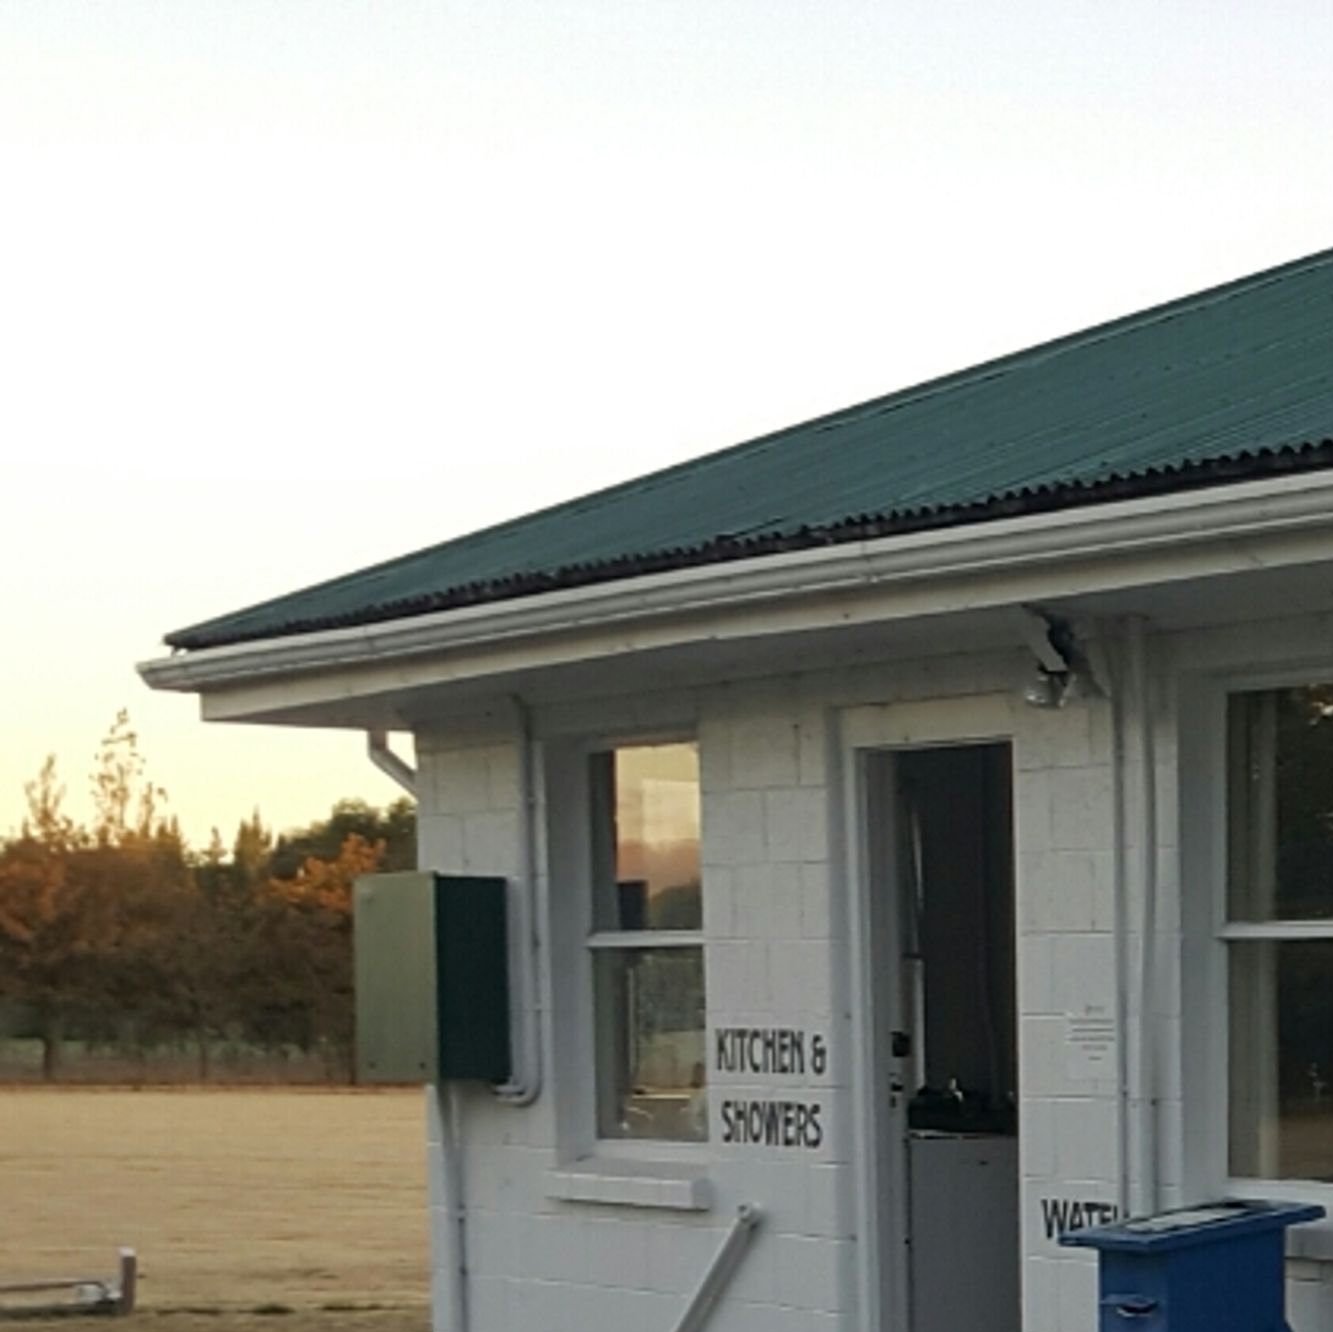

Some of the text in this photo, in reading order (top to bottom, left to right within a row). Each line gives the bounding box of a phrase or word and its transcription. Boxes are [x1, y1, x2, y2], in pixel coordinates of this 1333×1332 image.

[714, 1027, 827, 1076] KITCHEN &
[721, 1101, 823, 1148] SHOWERS
[1040, 1198, 1118, 1239] WATE
